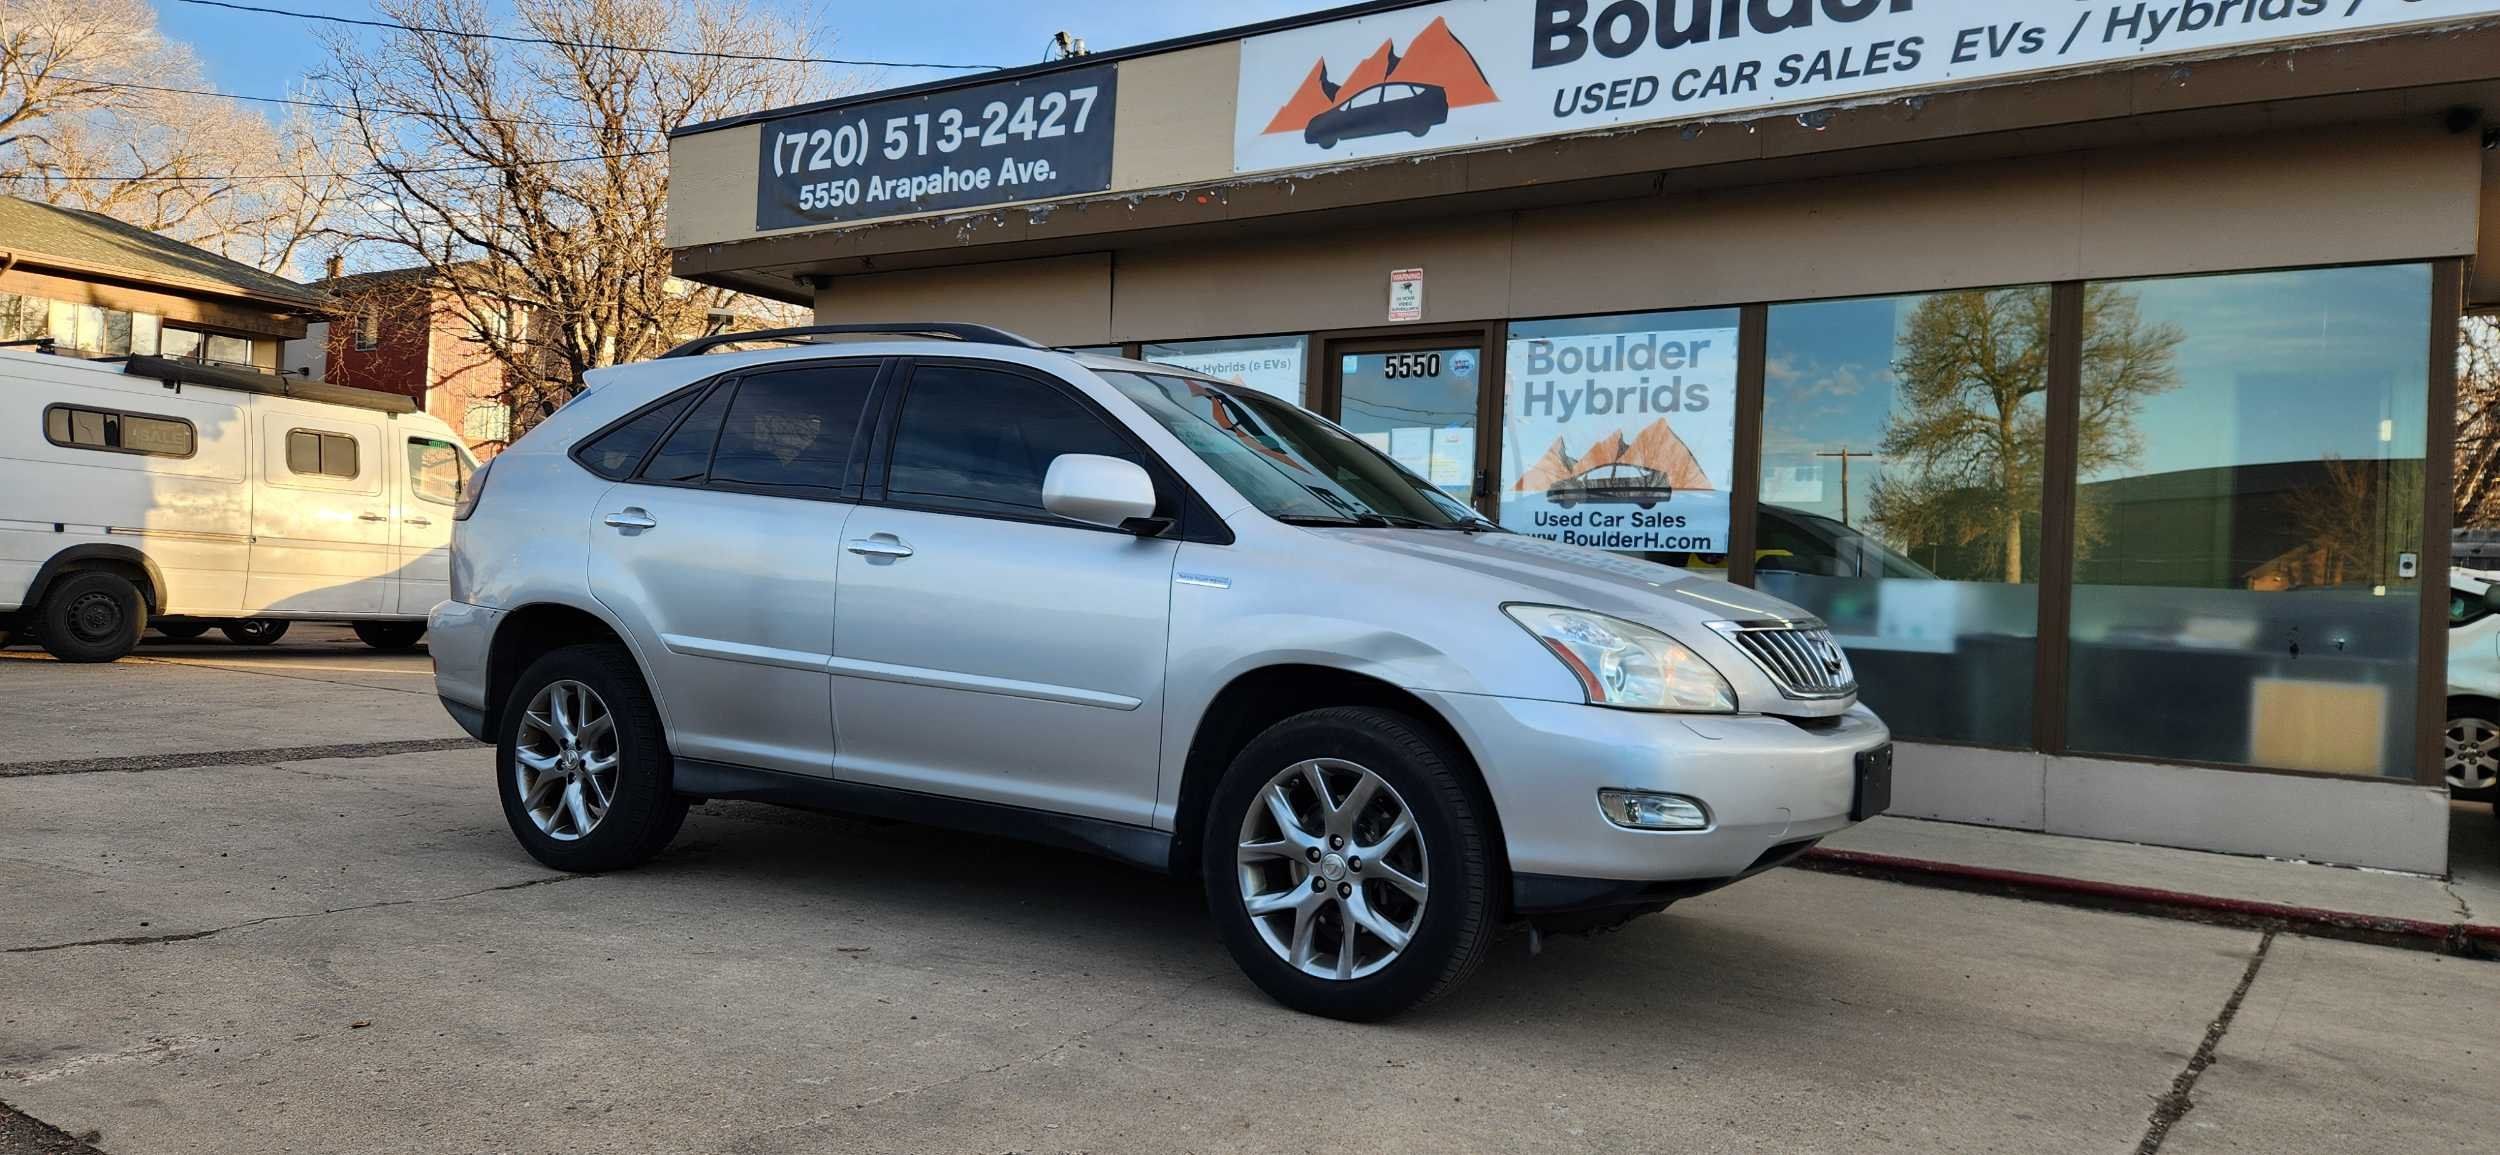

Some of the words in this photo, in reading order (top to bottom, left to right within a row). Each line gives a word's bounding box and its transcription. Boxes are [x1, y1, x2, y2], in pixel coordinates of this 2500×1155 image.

[1553, 75, 1659, 118] USED
[1671, 60, 1761, 102] CAR
[1774, 36, 1924, 88] SALES
[1950, 21, 2047, 64] EVs
[774, 118, 869, 177] (720)
[883, 86, 1098, 161] 513-2427
[799, 180, 860, 210] 5550
[866, 165, 991, 201] Arapahoe
[997, 157, 1057, 185] Ave.
[1203, 361, 1246, 374] Hybrids
[1263, 358, 1292, 370] EVs)
[1384, 353, 1441, 379] 5550
[1527, 334, 1711, 375] Boulder
[1523, 375, 1711, 424] Hybrids
[1534, 511, 1583, 527] Used
[1588, 511, 1625, 528] Car
[1631, 511, 1687, 528] Sales
